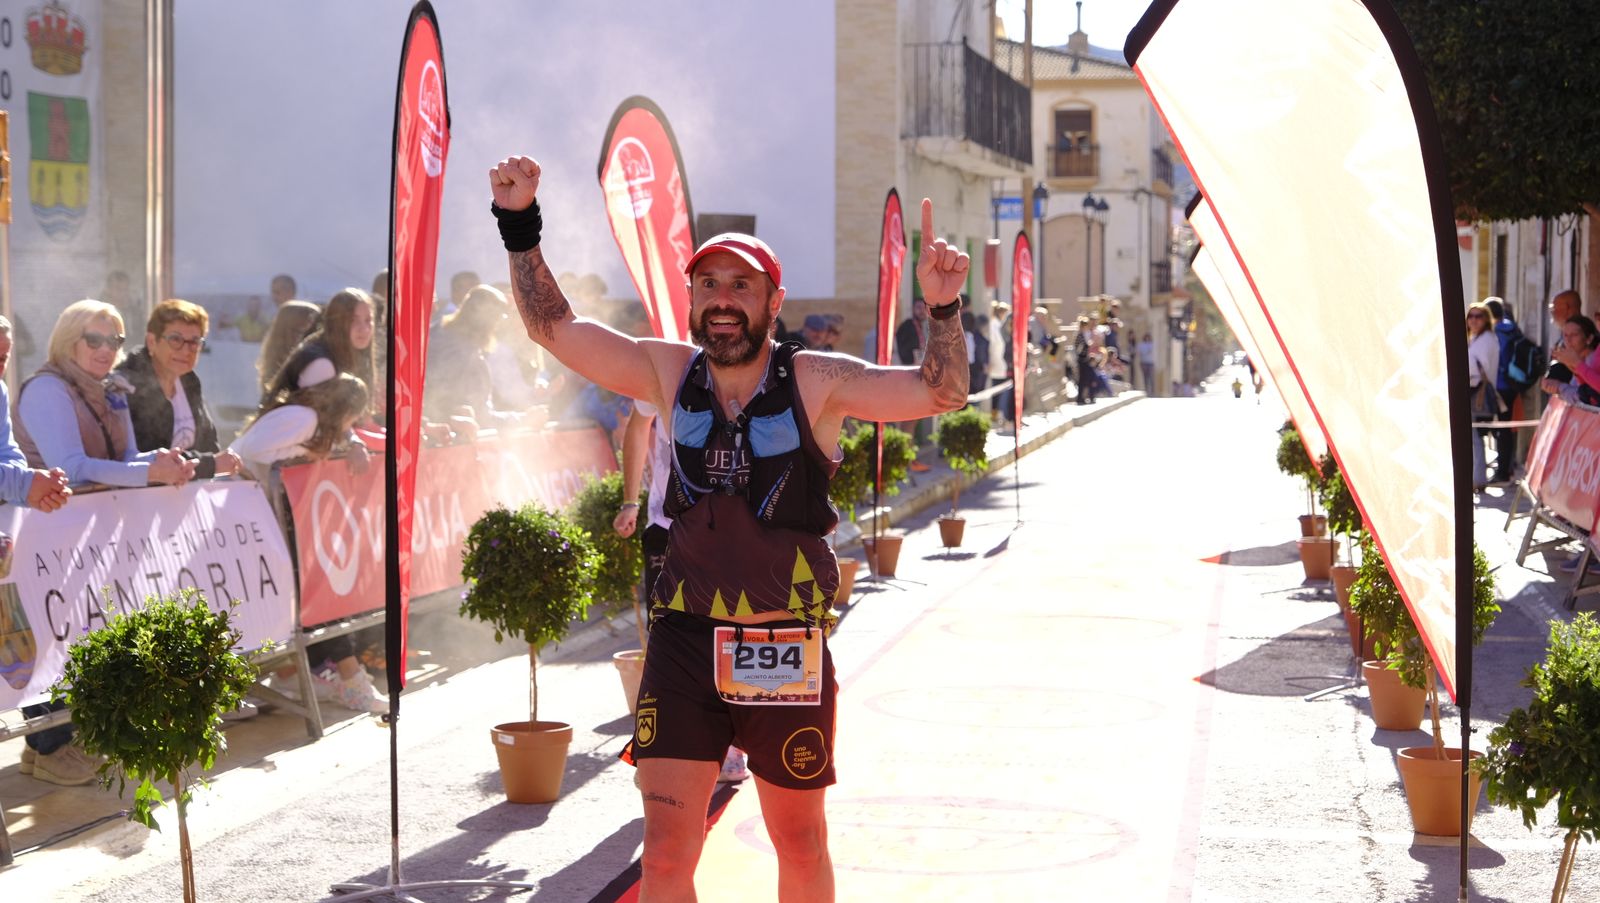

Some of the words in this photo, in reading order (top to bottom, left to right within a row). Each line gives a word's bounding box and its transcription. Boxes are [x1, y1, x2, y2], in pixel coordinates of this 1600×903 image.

[235, 521, 264, 545] DE
[360, 491, 469, 562] VOLIA
[734, 646, 802, 670] 294
